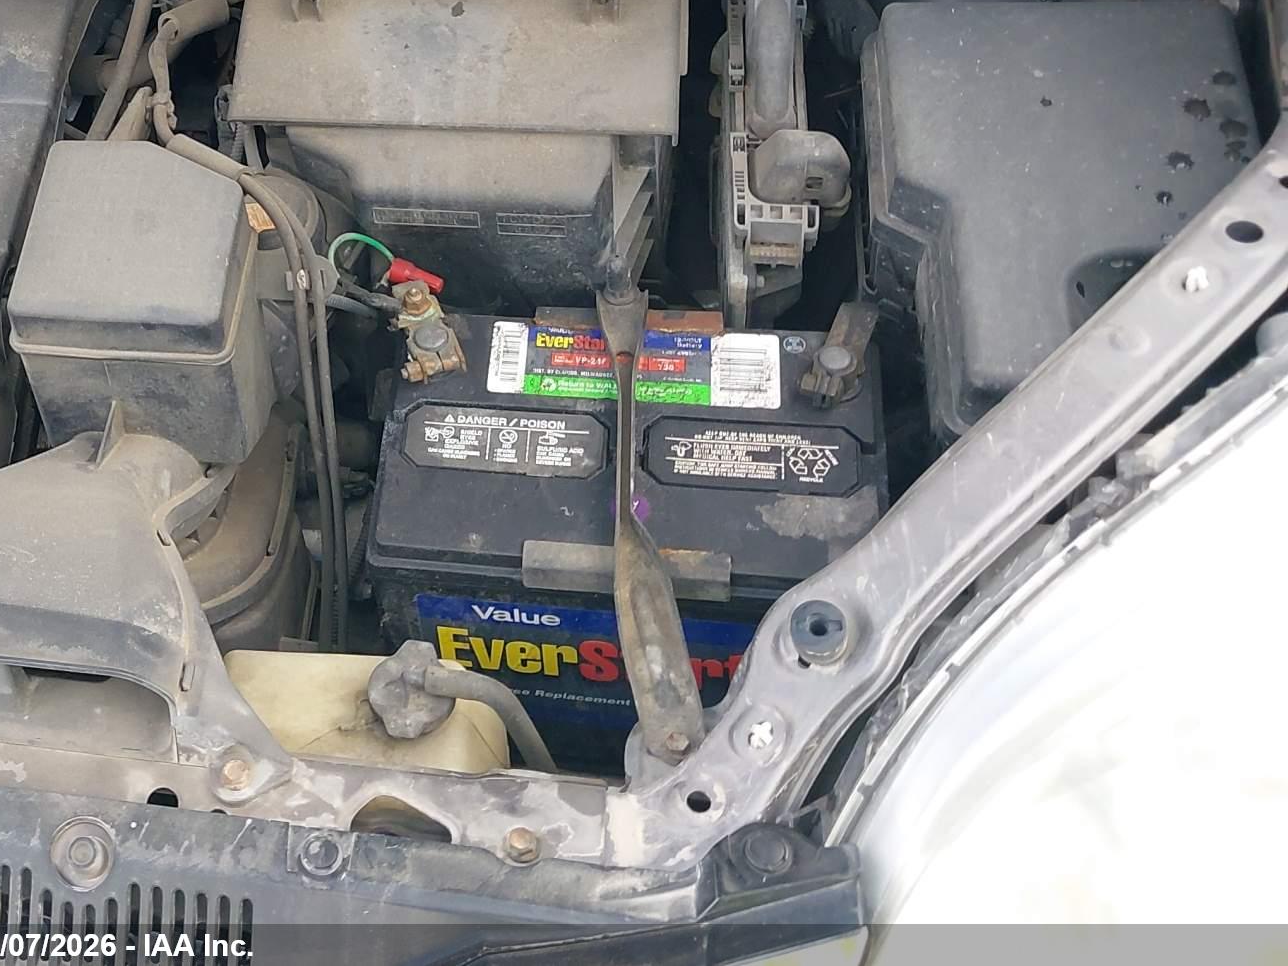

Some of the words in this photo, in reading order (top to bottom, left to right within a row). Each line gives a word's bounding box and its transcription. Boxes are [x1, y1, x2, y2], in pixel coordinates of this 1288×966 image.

[457, 415, 507, 426] DANGER
[520, 419, 565, 430] POISON
[471, 604, 561, 627] Value
[534, 689, 631, 707] Replacement
